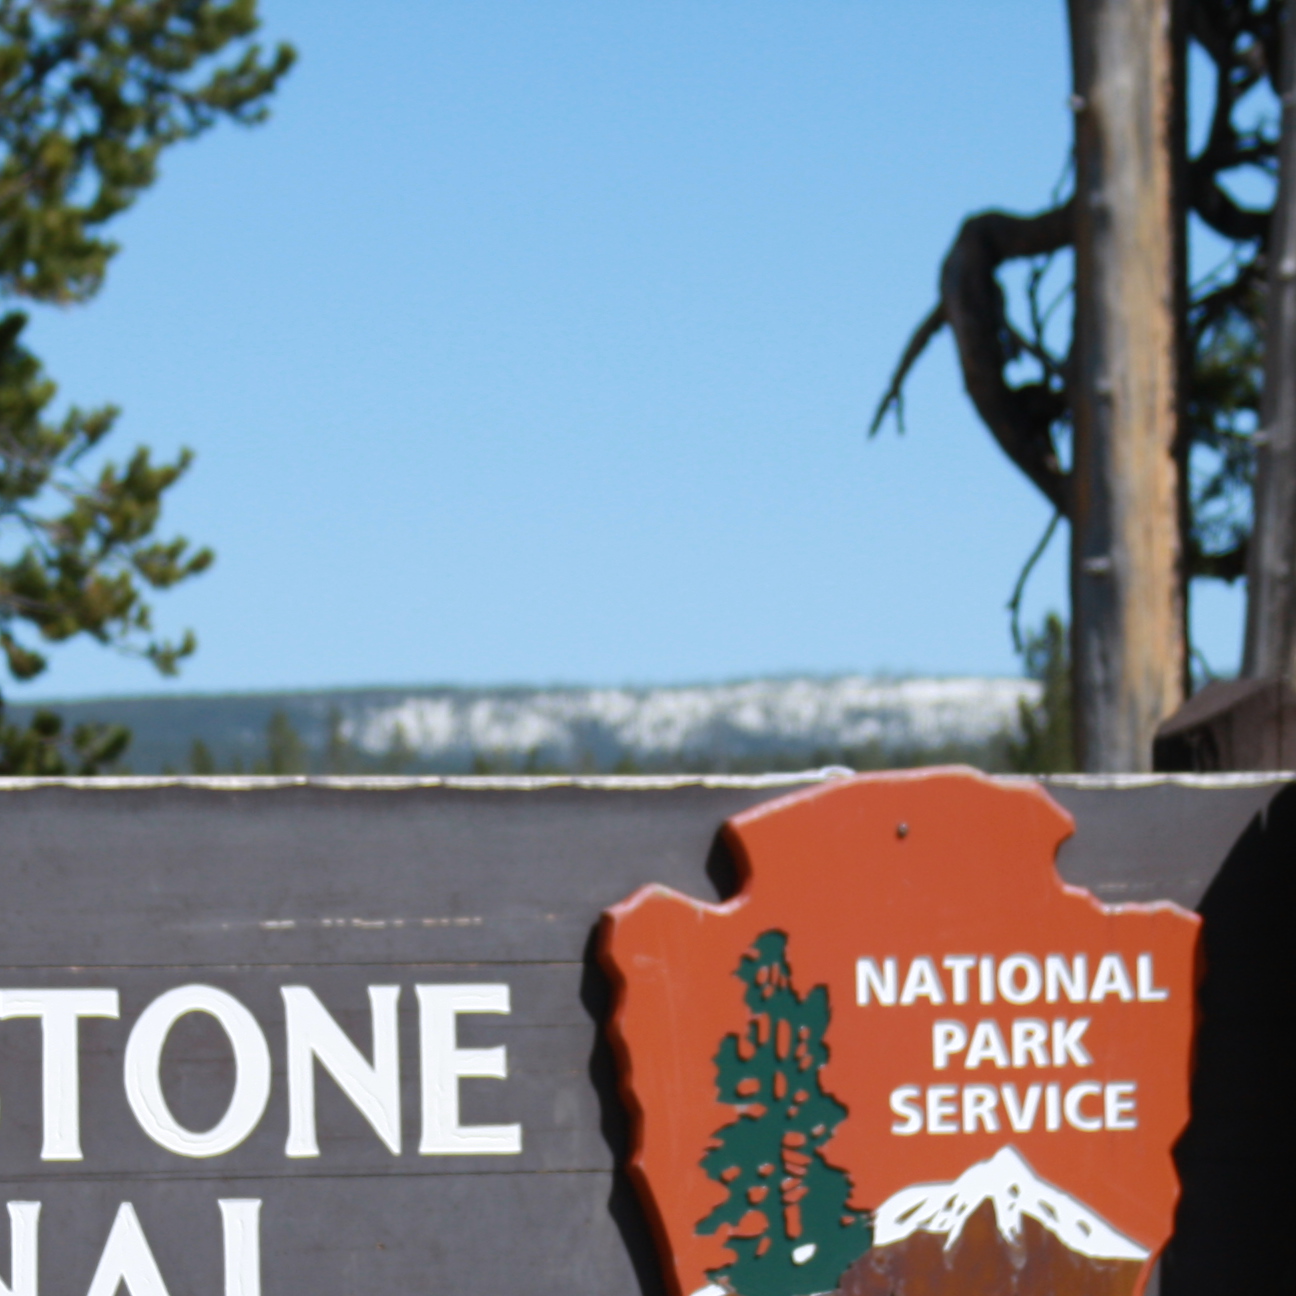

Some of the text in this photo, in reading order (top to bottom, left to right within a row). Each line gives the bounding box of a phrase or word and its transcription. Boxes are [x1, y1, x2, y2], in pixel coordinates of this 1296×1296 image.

[855, 952, 1170, 1006] NATIONAL
[932, 1016, 1094, 1070] PARK
[889, 1079, 1140, 1136] SERVICE
